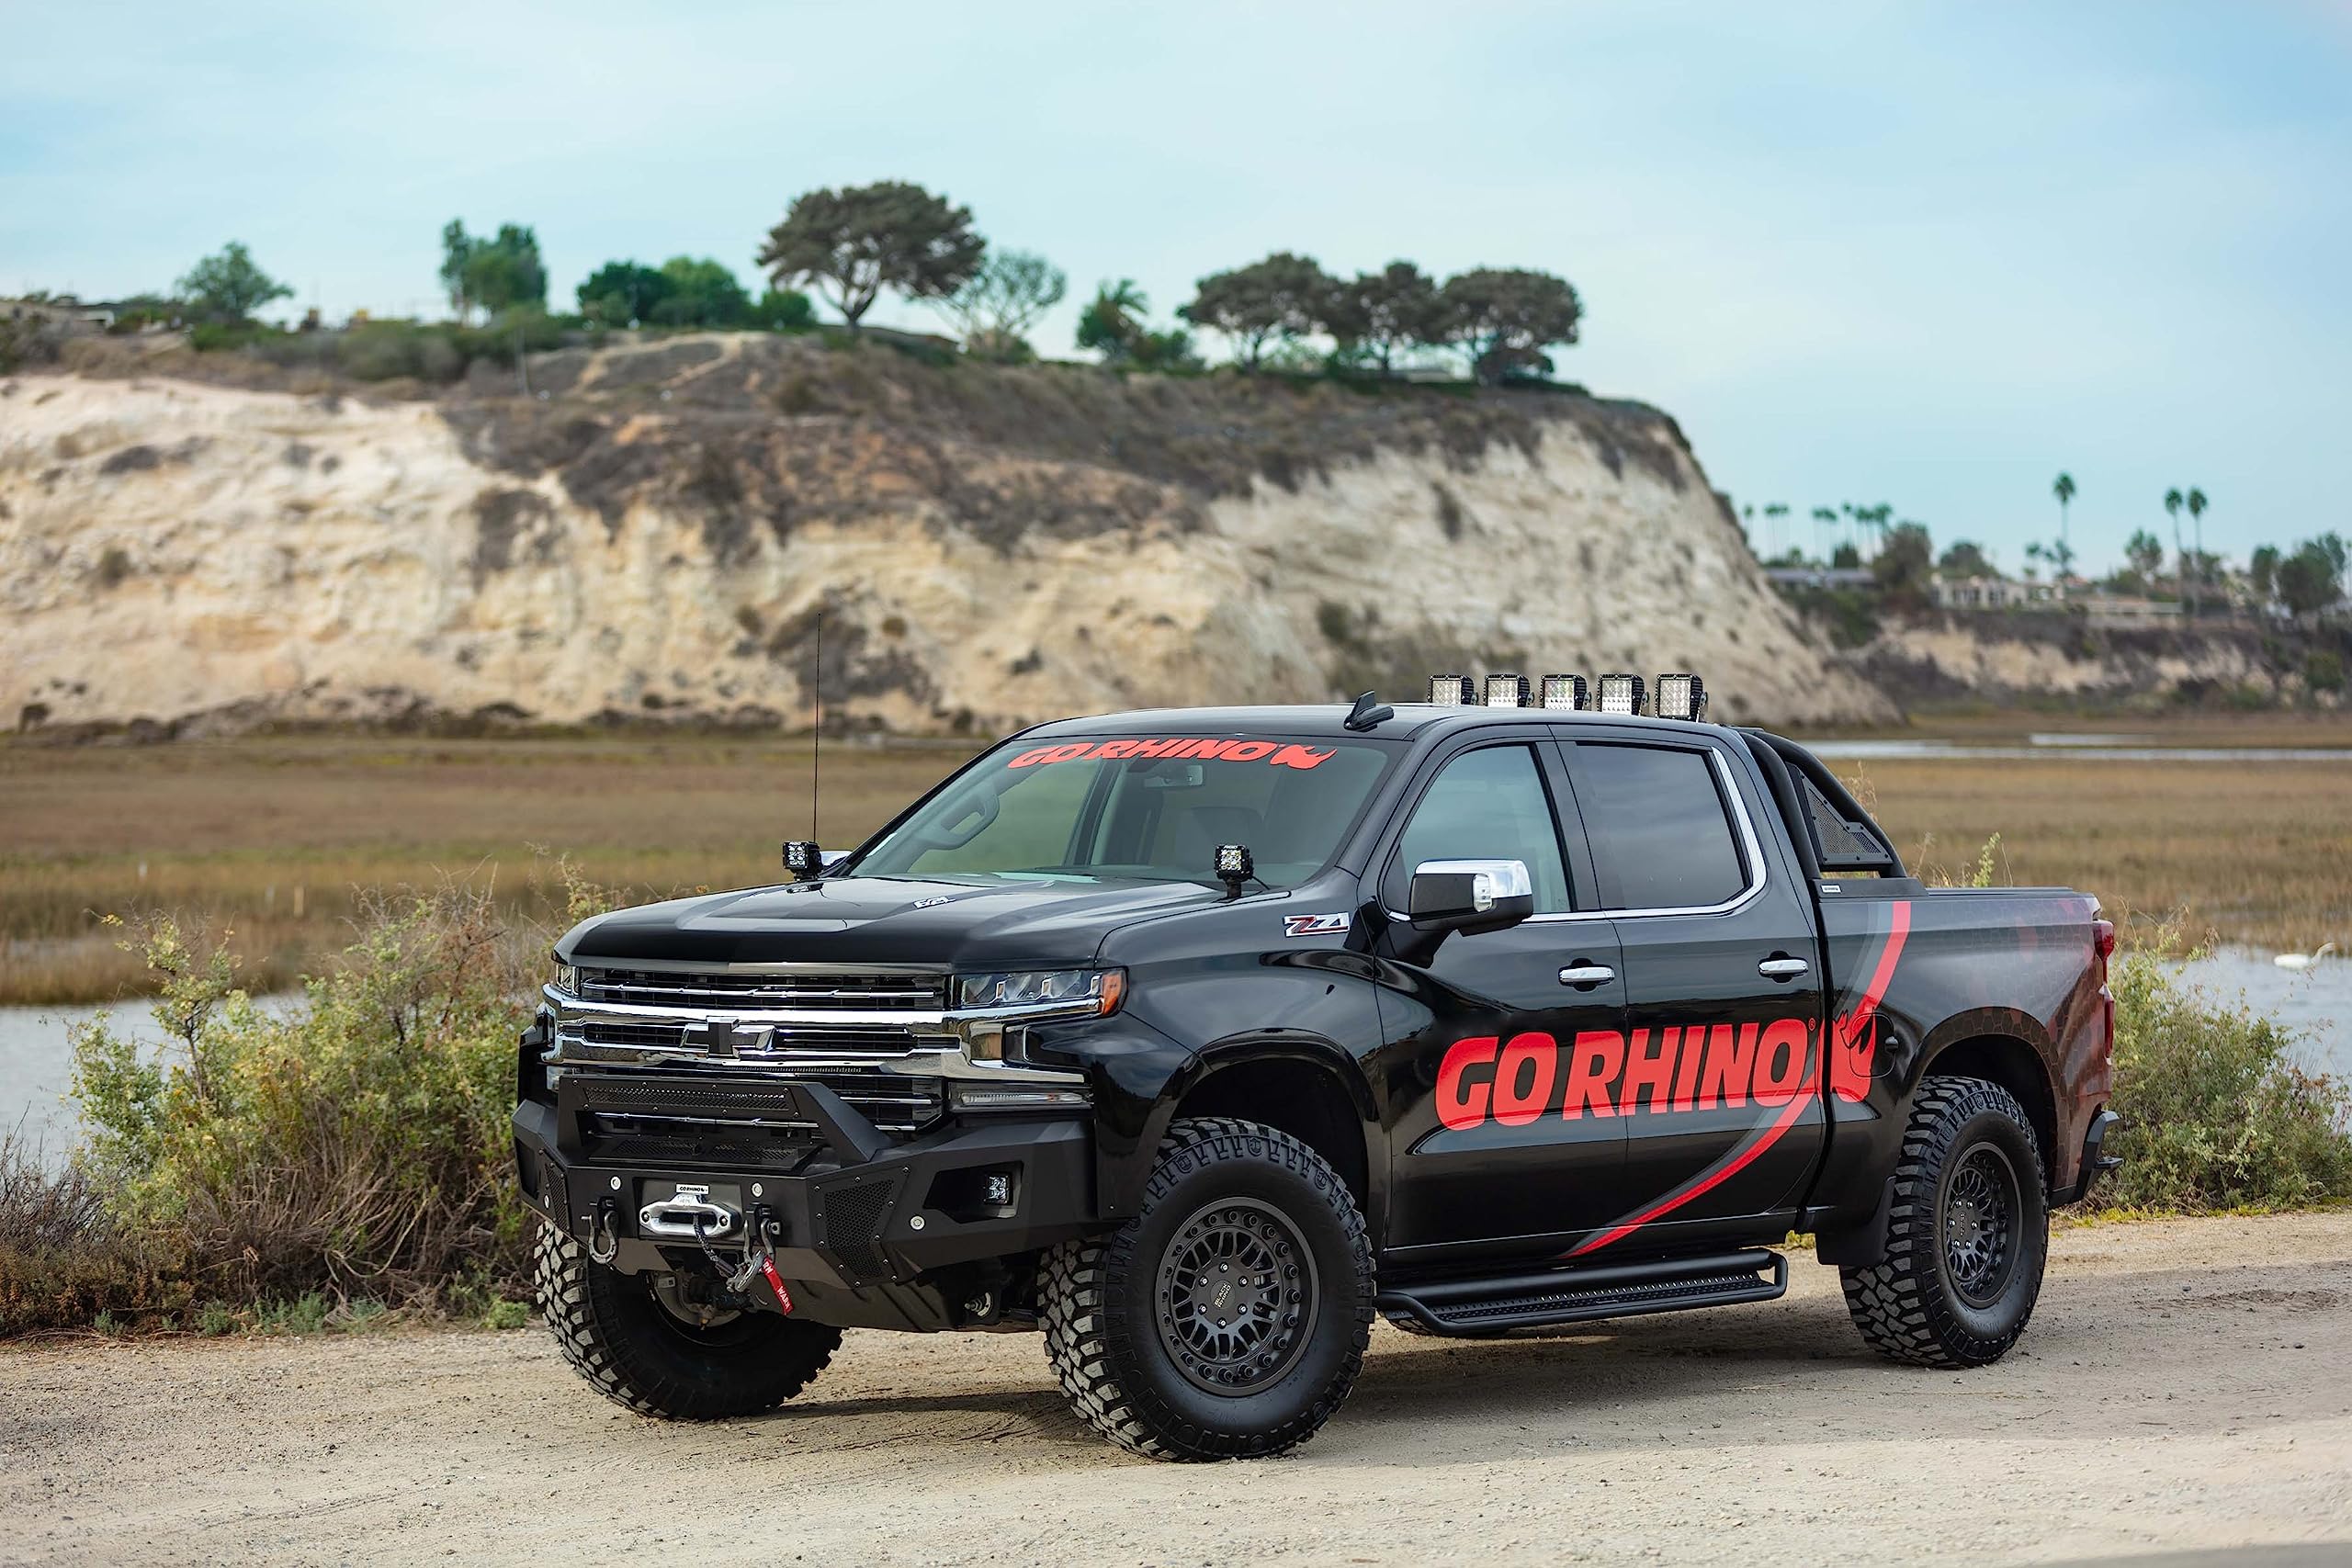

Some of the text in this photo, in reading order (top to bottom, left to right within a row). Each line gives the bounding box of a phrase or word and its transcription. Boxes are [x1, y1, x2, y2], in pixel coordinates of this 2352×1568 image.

[1007, 739, 1279, 769] GO RHINO
[1434, 1018, 1809, 1132] GO RHINO
